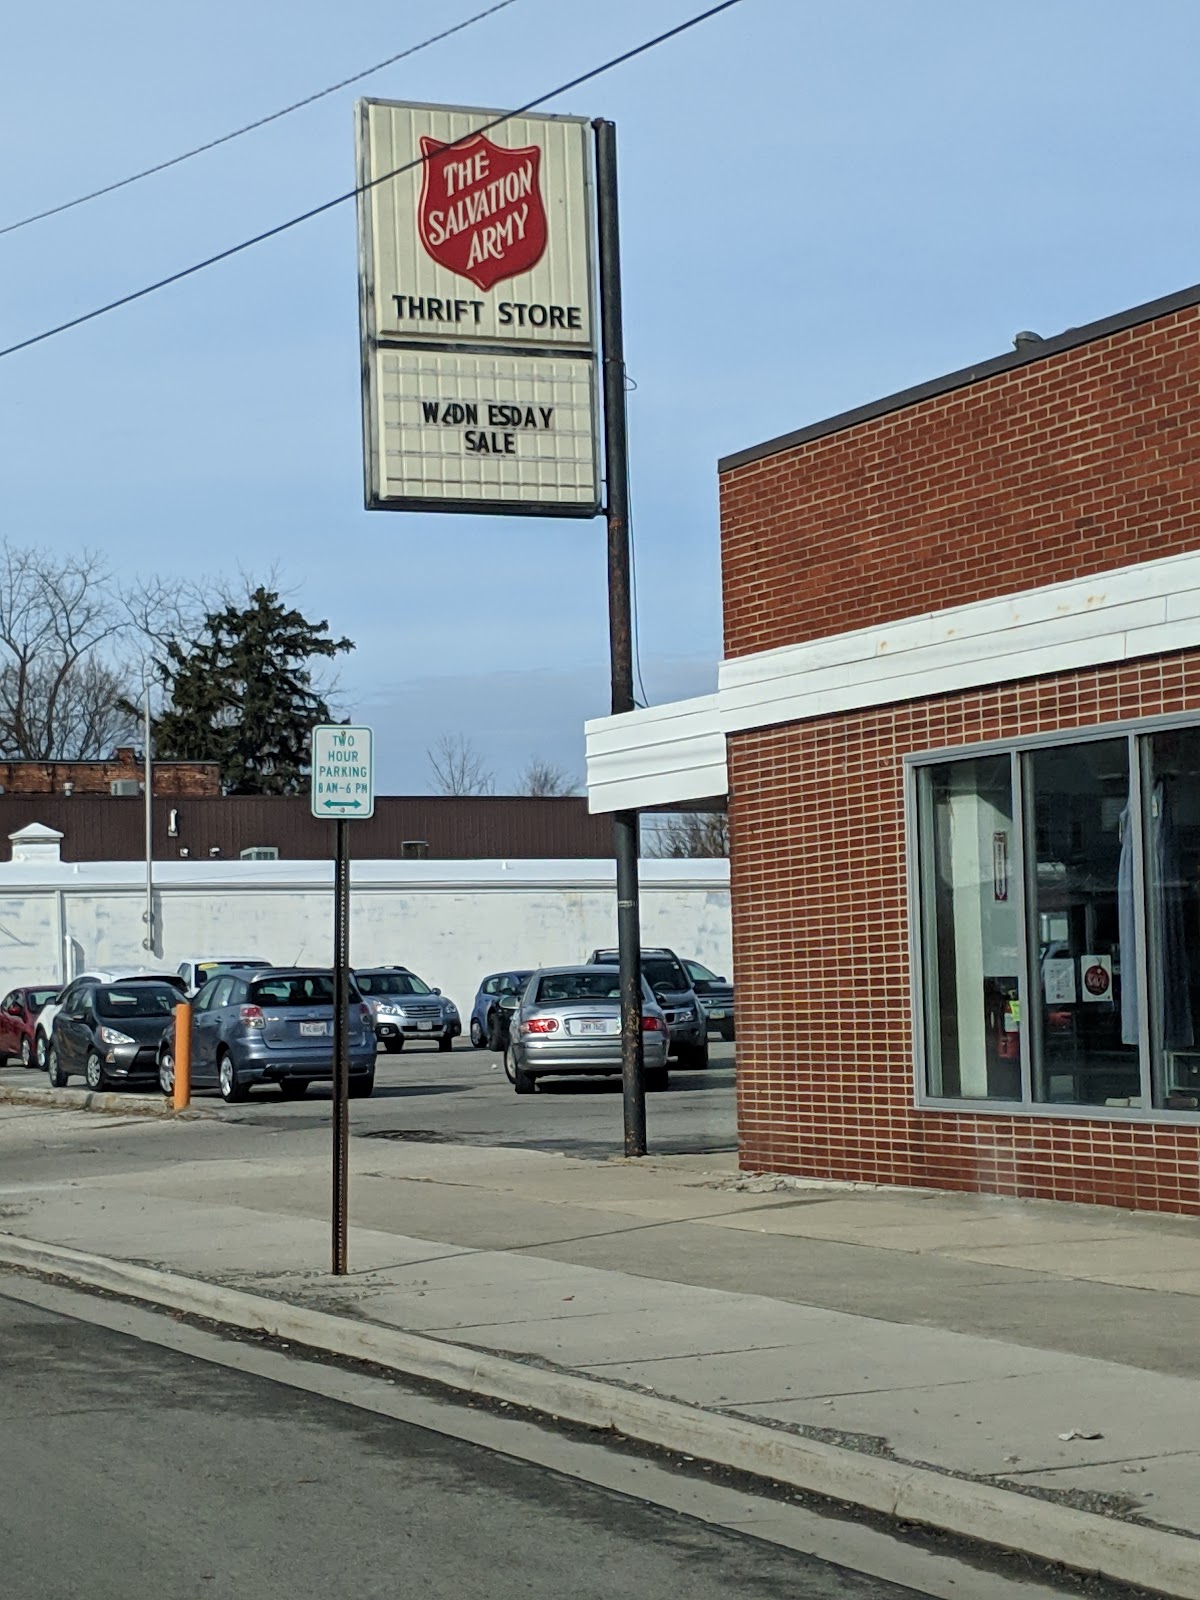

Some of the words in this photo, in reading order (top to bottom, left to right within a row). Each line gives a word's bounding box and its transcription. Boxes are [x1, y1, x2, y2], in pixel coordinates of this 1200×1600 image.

[443, 150, 490, 197] THE
[428, 159, 533, 246] SALVATION
[466, 203, 529, 270] ARMY
[392, 294, 484, 323] THRIFT
[498, 302, 582, 329] STORE
[464, 430, 516, 454] SALE
[332, 735, 355, 747] TWO
[328, 751, 359, 762] HOUR
[319, 766, 367, 778] PARKING
[355, 783, 368, 794] PM
